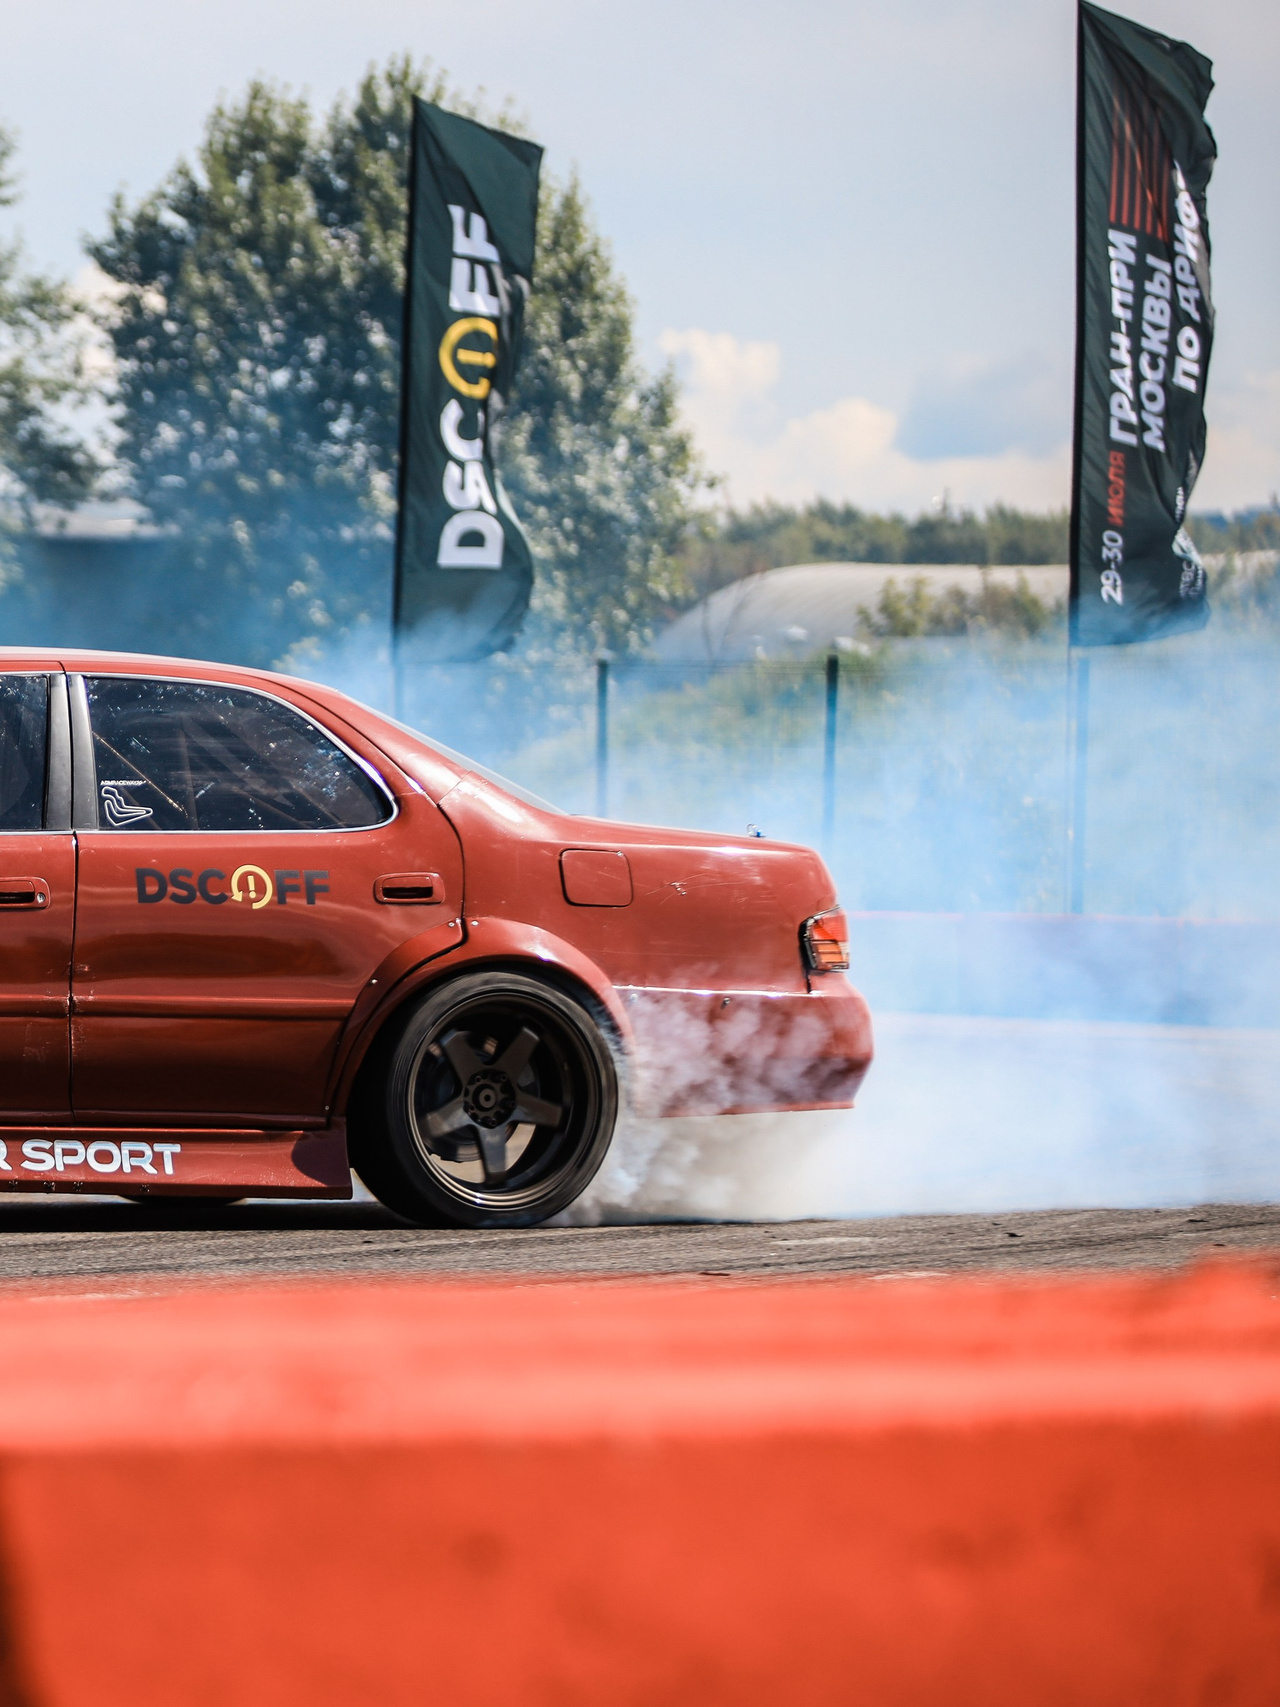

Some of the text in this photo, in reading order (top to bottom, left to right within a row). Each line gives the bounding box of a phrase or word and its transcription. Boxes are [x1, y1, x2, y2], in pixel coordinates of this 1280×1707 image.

[1107, 228, 1138, 448] ГРАН-ПРИ
[1139, 253, 1172, 453] МОСКВЫ
[1172, 326, 1201, 394] ПО
[1101, 450, 1125, 606] 29-30 ИЮЛЯ
[21, 1139, 181, 1175] SPORT
